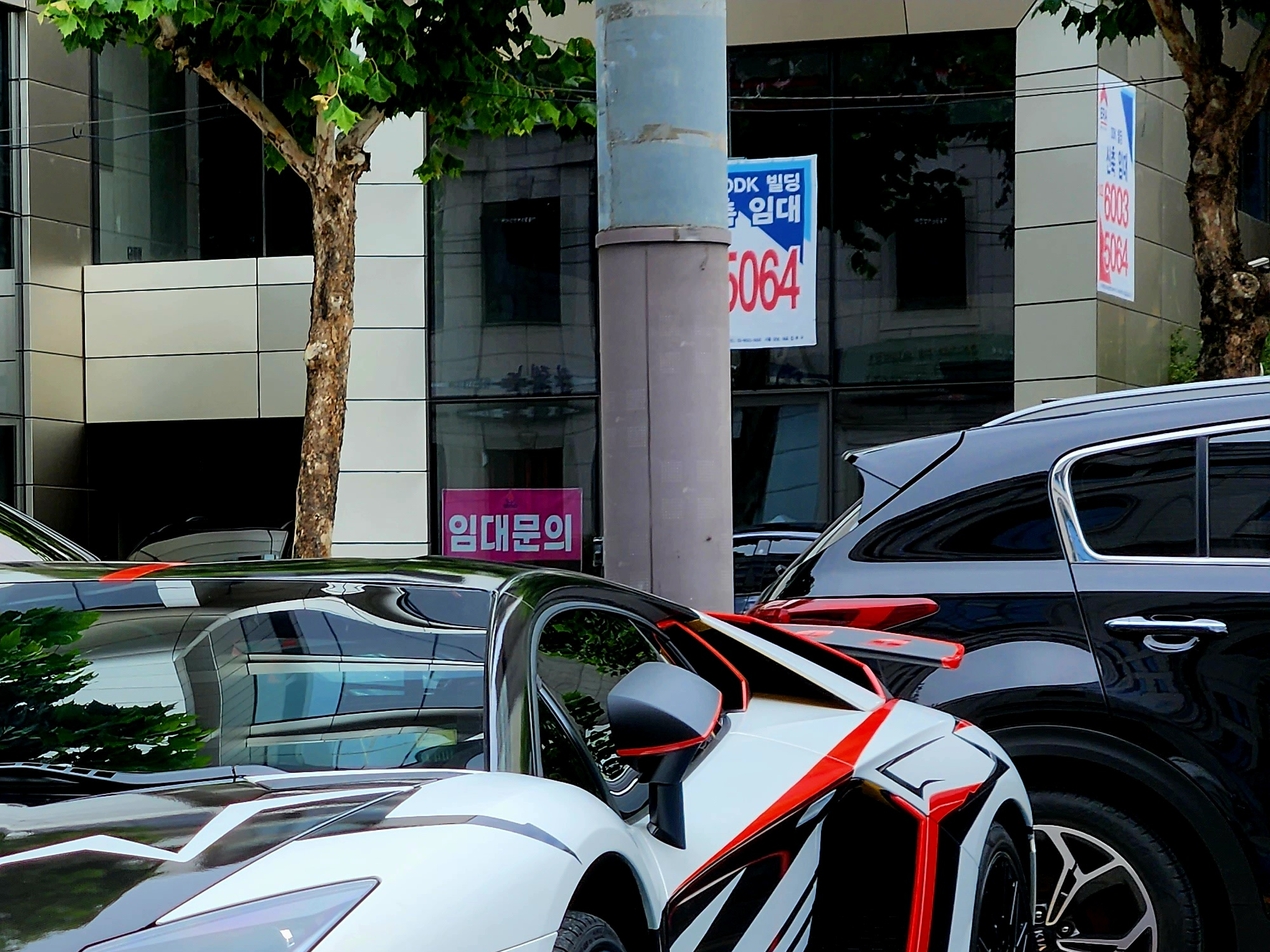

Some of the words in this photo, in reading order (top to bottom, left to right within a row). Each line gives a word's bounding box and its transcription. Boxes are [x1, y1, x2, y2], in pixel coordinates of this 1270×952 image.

[766, 172, 801, 193] 빌딩
[748, 194, 801, 226] 임대
[1104, 181, 1129, 229] 6003
[1104, 231, 1128, 277] 5064
[448, 514, 572, 552] 임대문의
